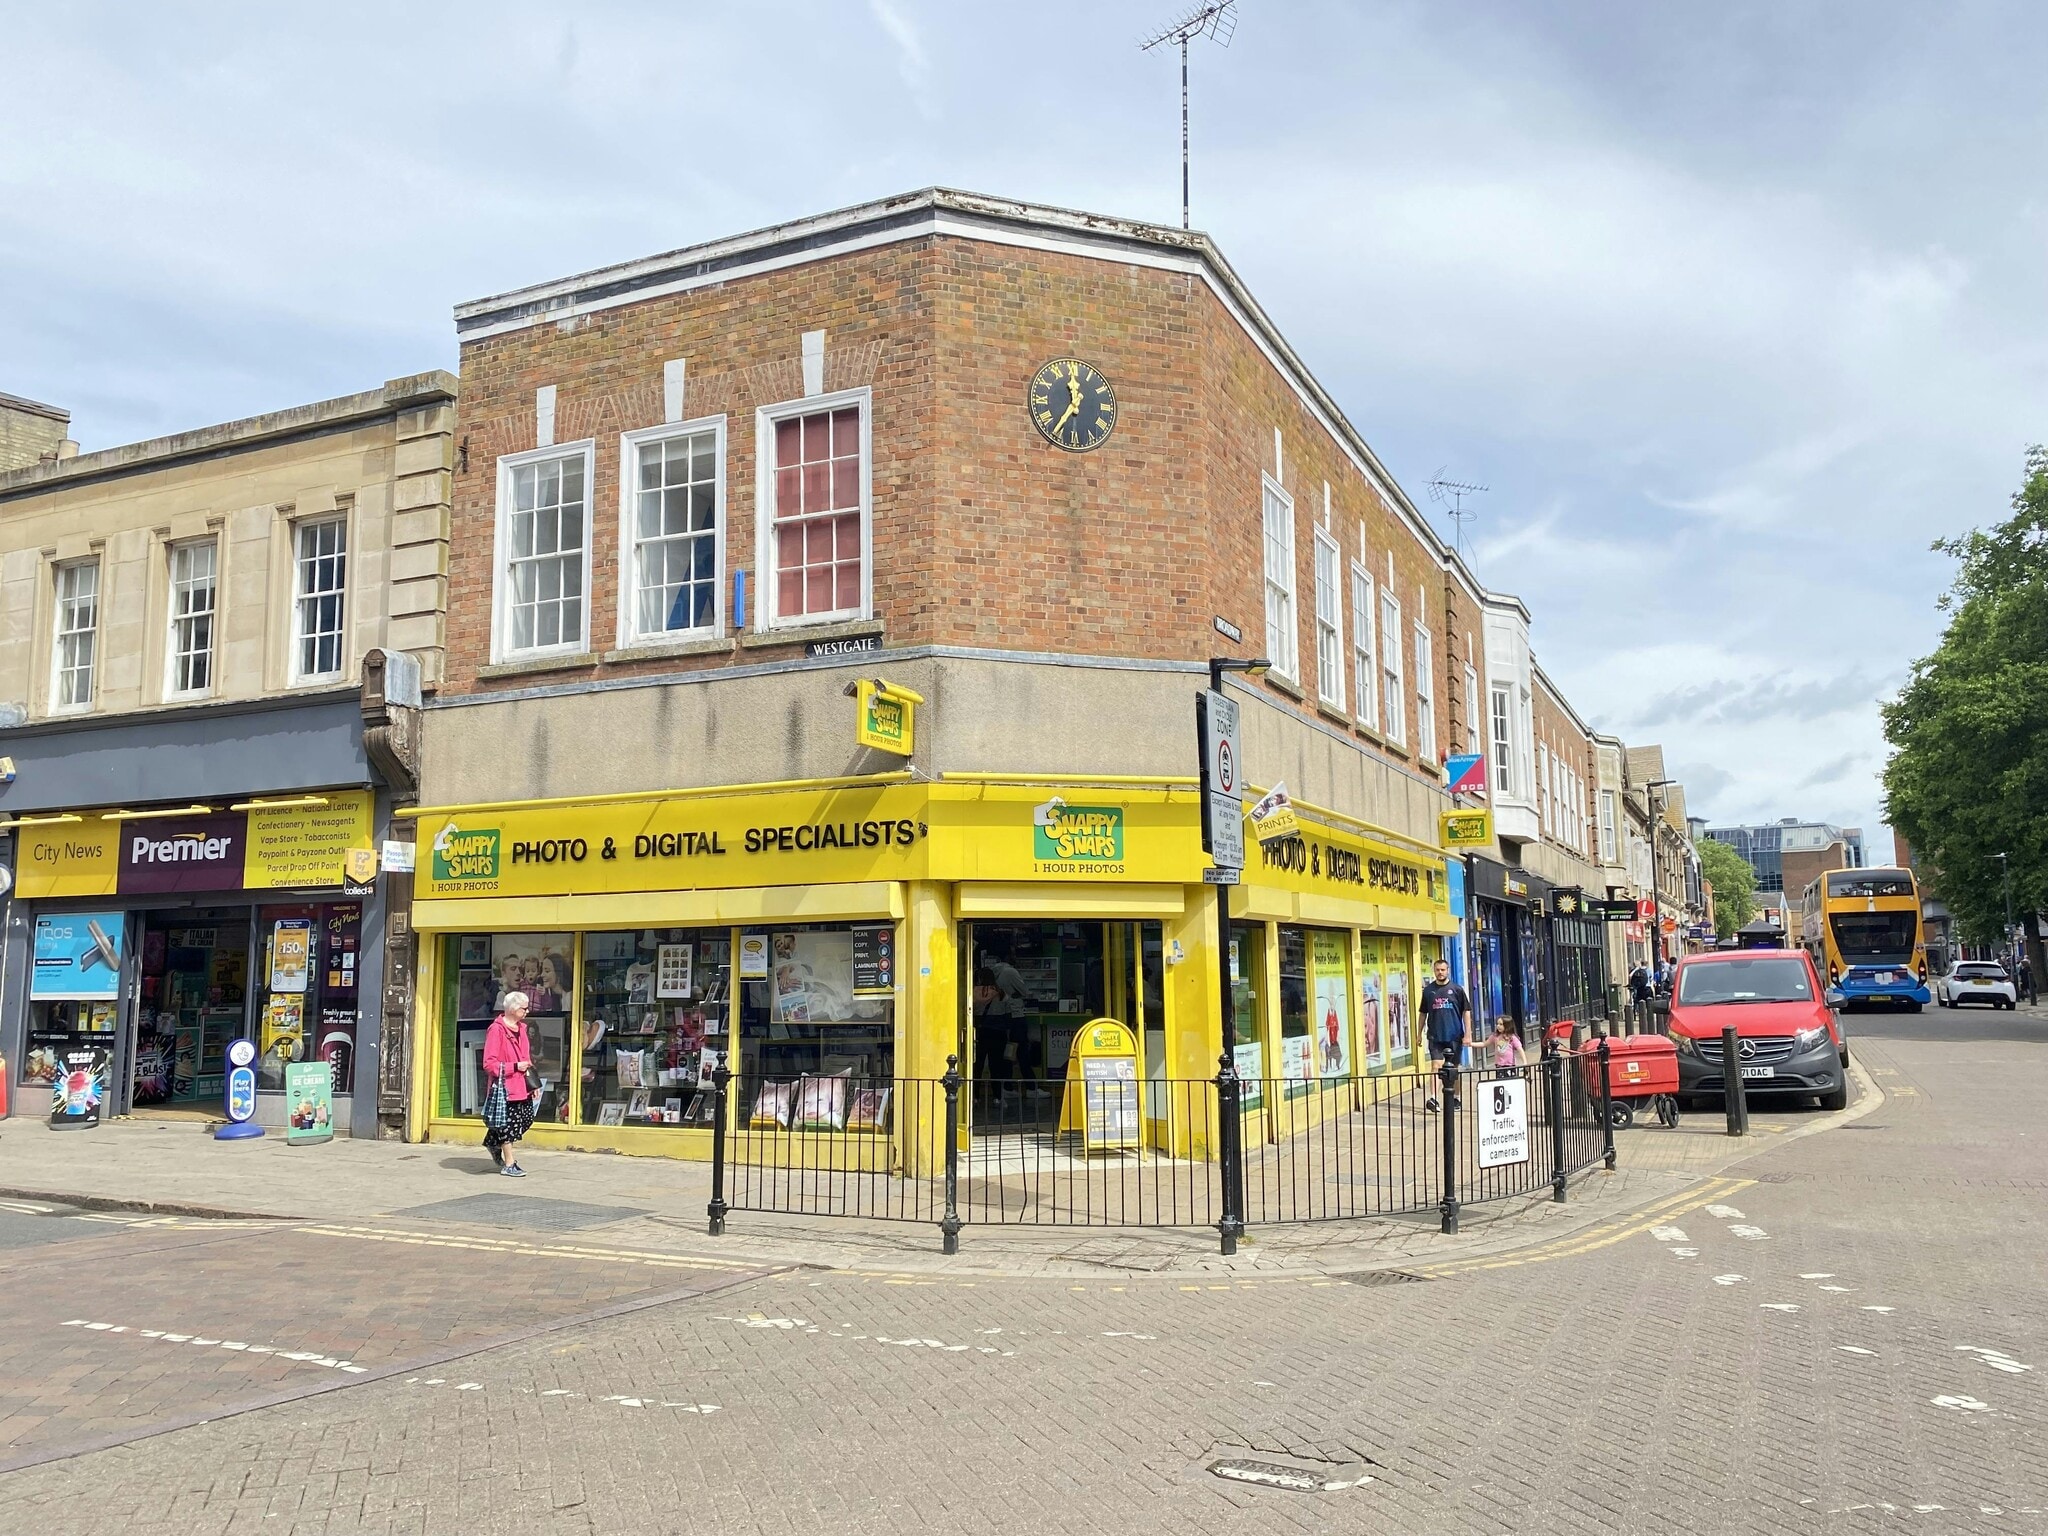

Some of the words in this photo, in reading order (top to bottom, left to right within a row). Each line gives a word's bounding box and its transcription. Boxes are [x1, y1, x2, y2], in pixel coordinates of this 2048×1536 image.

[813, 637, 875, 656] WESTGATE
[1217, 718, 1232, 738] ZONE
[255, 808, 266, 816] Off
[267, 806, 293, 815] Licence
[302, 805, 331, 813] National
[333, 802, 359, 813] Lottery
[257, 820, 305, 833] Confectionery
[311, 817, 356, 828] Newsagents
[1044, 808, 1118, 840] SNAPPY
[1257, 814, 1294, 833] PRINTS
[260, 836, 278, 845] Vape
[279, 834, 298, 843] Store
[304, 832, 351, 842] Tobacconists
[512, 837, 588, 864] PHOTO
[601, 836, 617, 860] &
[634, 830, 726, 858] DIGITAL
[744, 820, 914, 853] SPECIALISTS
[1055, 834, 1116, 858] SNAPS
[34, 843, 60, 864] City
[64, 841, 102, 860] News
[131, 833, 231, 863] Premier
[258, 850, 288, 861] Paypoint
[290, 849, 295, 857] &
[297, 847, 327, 859] Payzone
[441, 834, 496, 862] SNAPPY
[267, 864, 289, 872] Parcel
[289, 863, 306, 873] Drop
[308, 862, 320, 870] Off
[321, 862, 339, 870] Point
[448, 856, 493, 878] SNAPS
[1034, 863, 1038, 873] 1
[1043, 863, 1076, 873] HOUR
[1079, 863, 1125, 874] PHOTOS
[1311, 843, 1320, 876] &
[1325, 845, 1364, 885] DIGITAL
[1368, 857, 1419, 896] SPECIALISTS
[270, 876, 314, 886] Convenience
[315, 876, 335, 885] Store
[431, 883, 435, 892] 1
[438, 882, 462, 892] HOUR
[464, 881, 499, 891] PHOTOS
[1641, 902, 1650, 917] L
[323, 1008, 339, 1018] Freshly
[339, 1009, 356, 1019] ground
[277, 1044, 293, 1058] £10
[143, 1064, 168, 1076] BLAST
[1750, 1068, 1769, 1076] OAC
[1492, 1118, 1515, 1130] Traffic
[1481, 1131, 1526, 1147] enforcement
[1489, 1148, 1519, 1160] cameras
